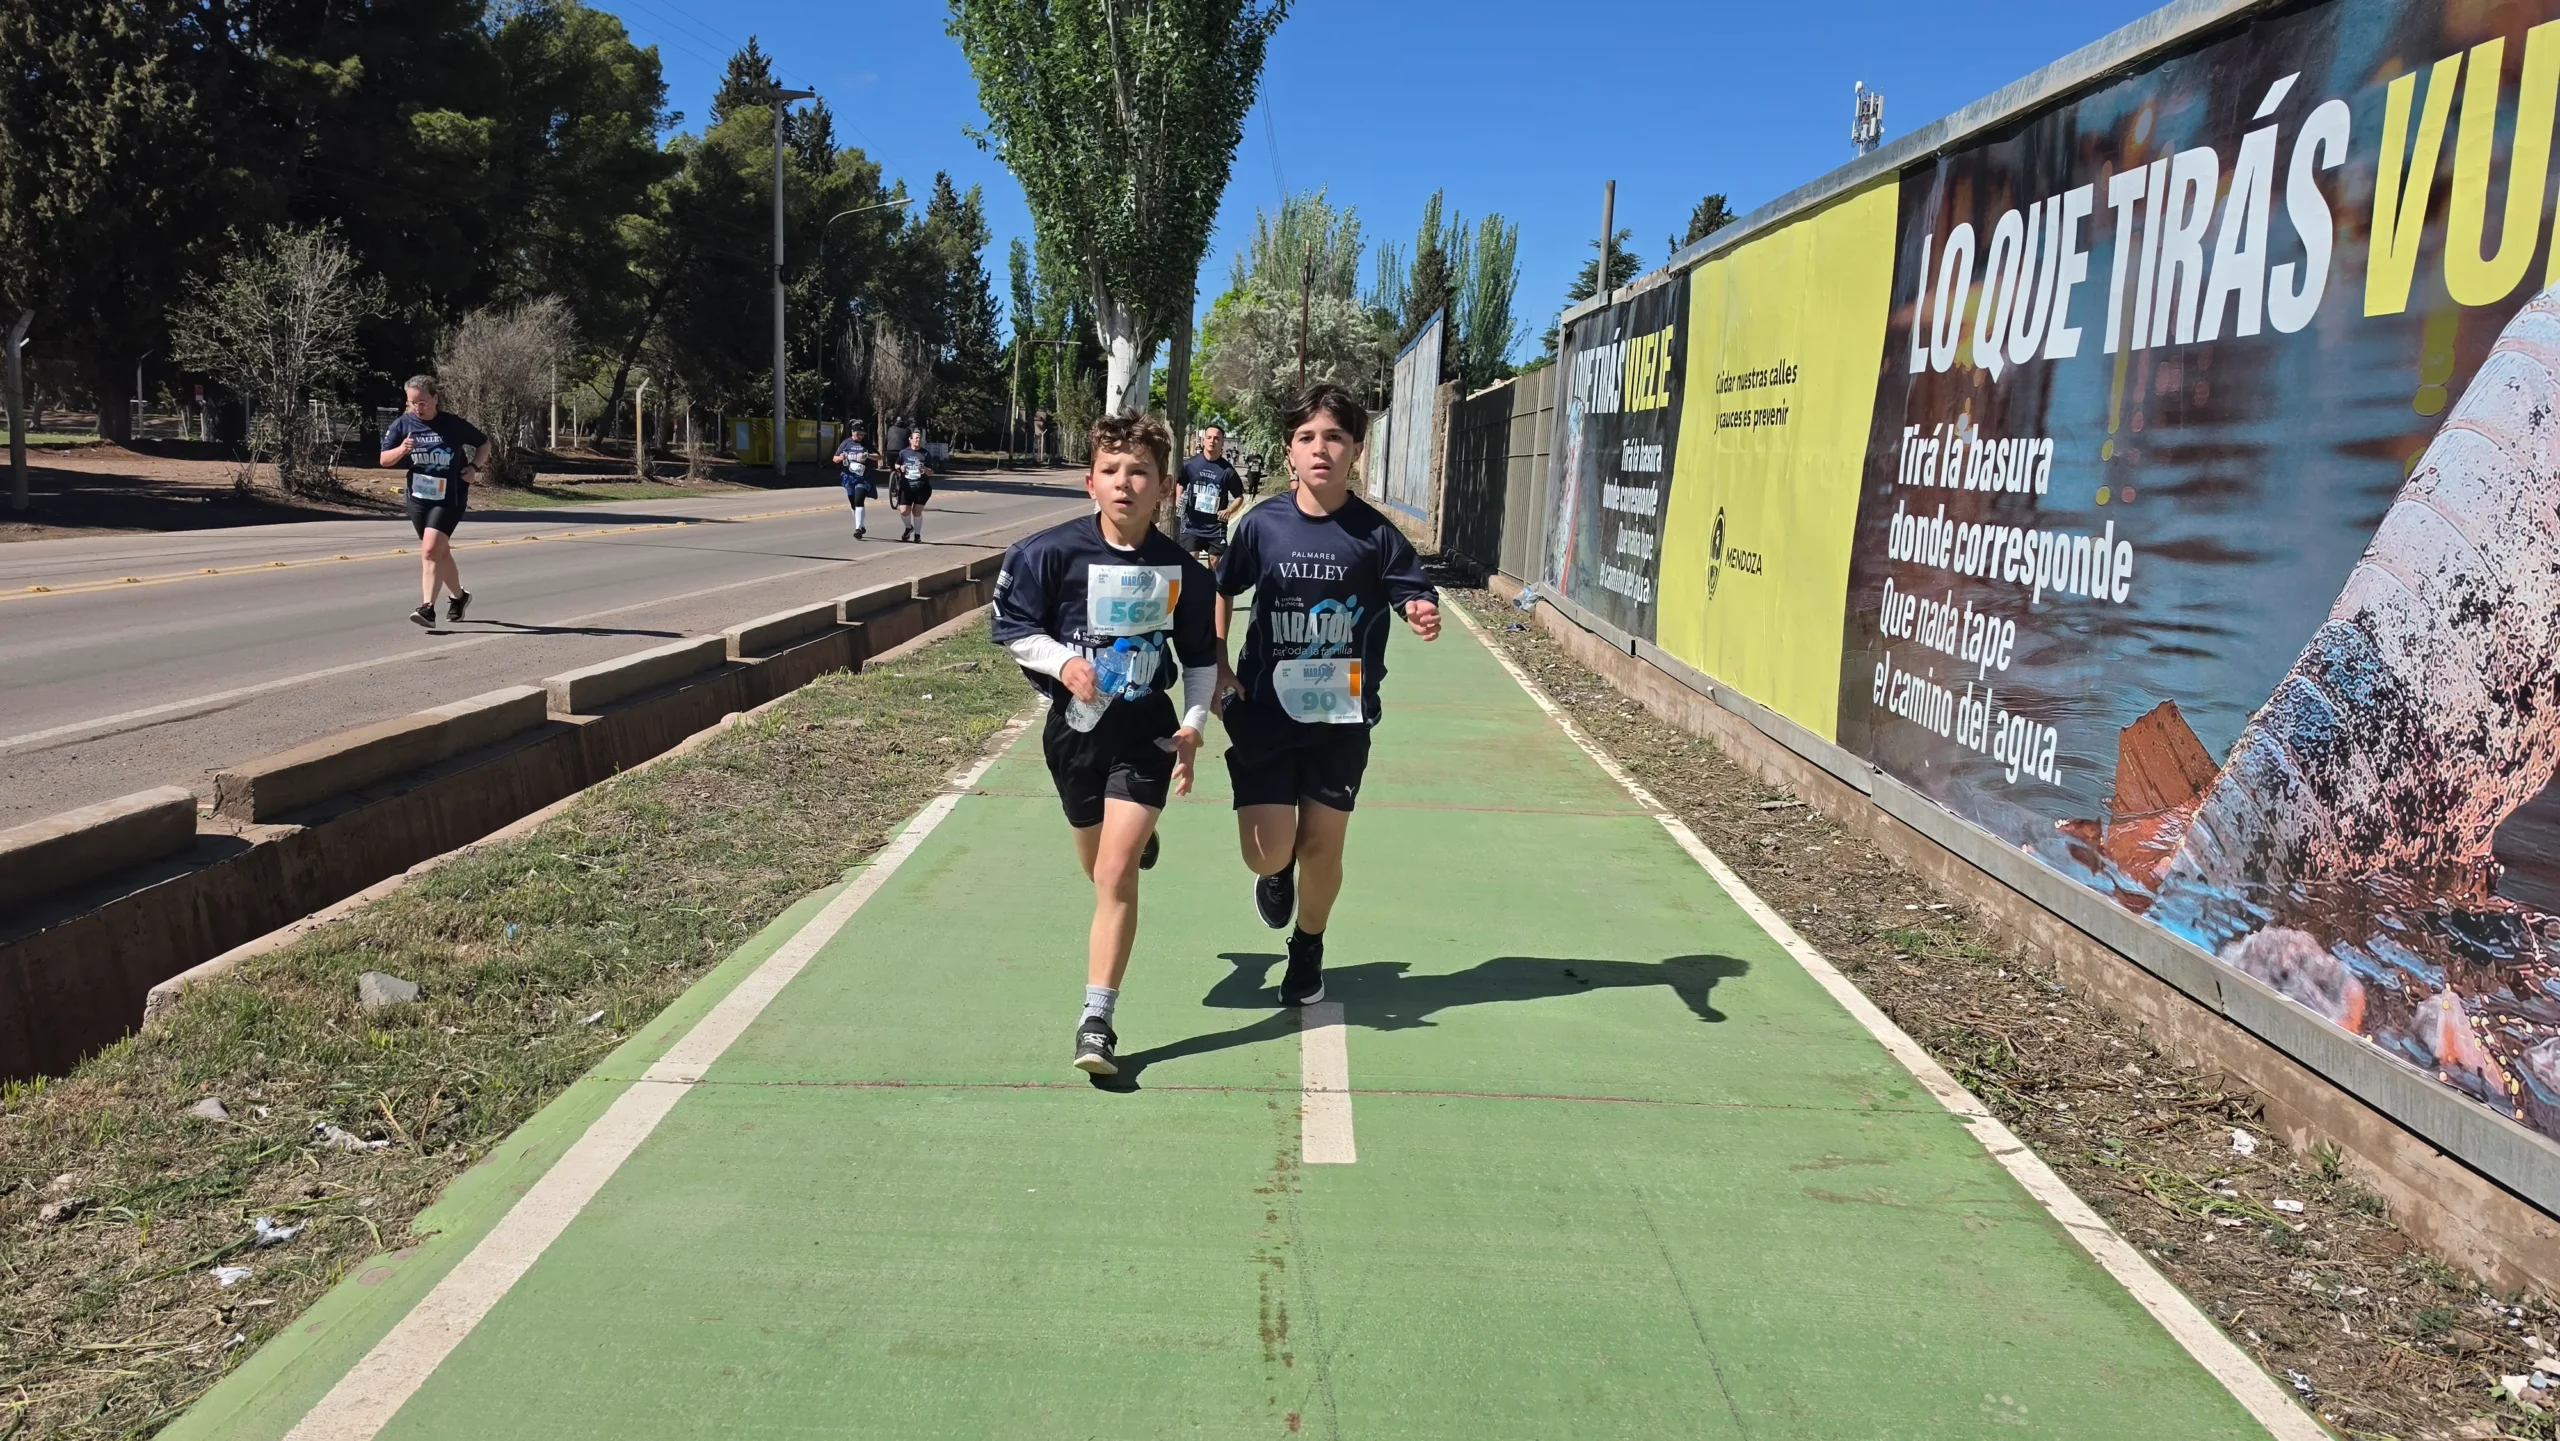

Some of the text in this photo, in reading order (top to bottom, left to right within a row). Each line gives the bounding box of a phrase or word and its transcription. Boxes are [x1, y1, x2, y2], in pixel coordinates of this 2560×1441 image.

[1909, 19, 2560, 383] LO QUE TIRÁS VU
[1591, 327, 1626, 414] TIRÁS
[1716, 358, 1798, 394] Cuidar nuestras calles
[1714, 397, 1789, 435] y cauces es prevenir
[1898, 423, 2054, 495] Tirá la basura
[1291, 551, 1336, 560] PALMARES
[1725, 547, 1762, 576] MENDOZA
[1888, 499, 2133, 604] donde corresponde
[1279, 562, 1348, 581] VALLEY
[1110, 601, 1161, 622] 562
[1879, 577, 2016, 681] Que nada tape
[1311, 645, 1319, 655] la
[1321, 645, 1353, 656] familia
[1302, 692, 1337, 711] 90
[1873, 650, 2062, 786] el camino del agua.
